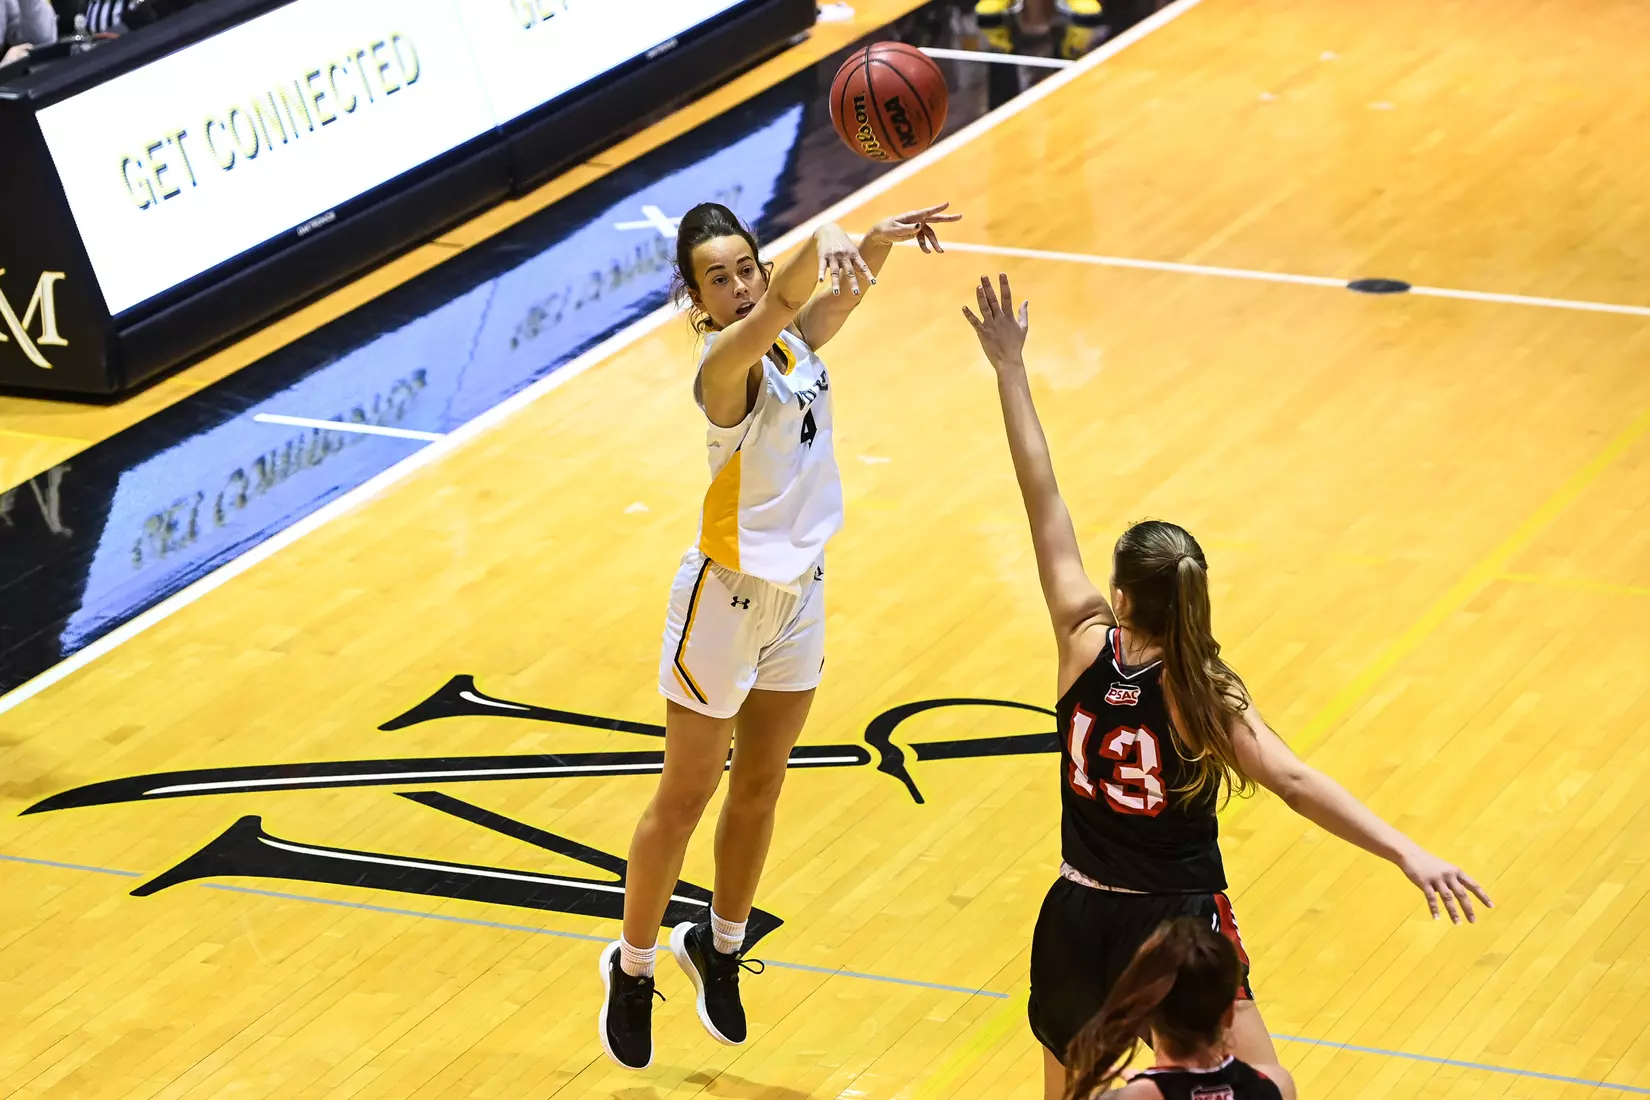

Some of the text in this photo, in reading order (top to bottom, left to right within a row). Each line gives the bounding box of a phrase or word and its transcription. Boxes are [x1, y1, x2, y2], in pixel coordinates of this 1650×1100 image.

[119, 32, 421, 211] GET CONNECTED
[883, 96, 917, 149] NCAA
[800, 407, 818, 451] 4
[1108, 688, 1139, 700] PSAC
[1067, 702, 1168, 818] 13
